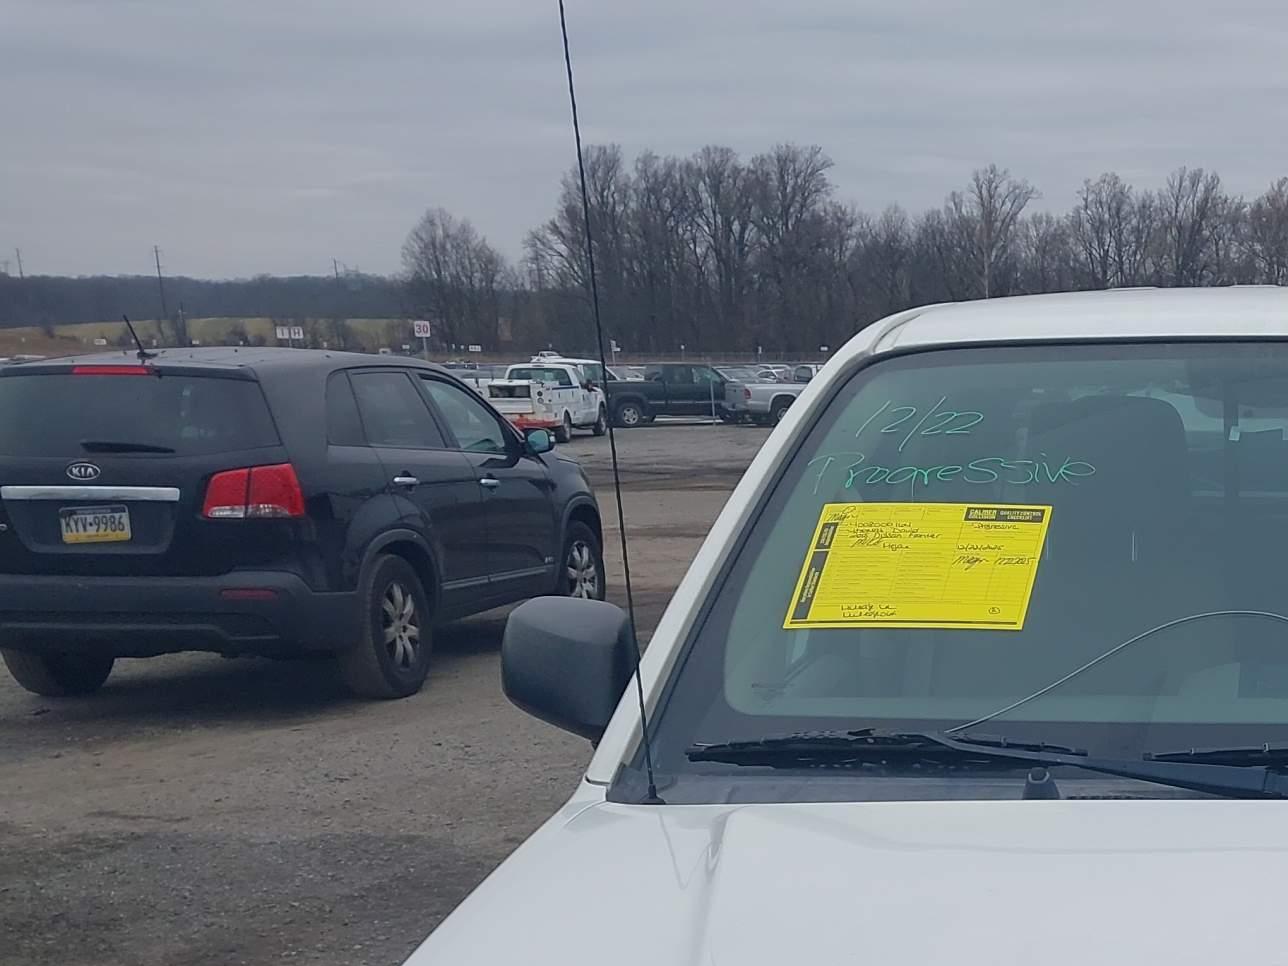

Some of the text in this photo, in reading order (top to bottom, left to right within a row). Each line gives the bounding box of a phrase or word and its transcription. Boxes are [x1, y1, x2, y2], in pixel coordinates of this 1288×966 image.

[415, 324, 429, 335] 30
[856, 396, 984, 451] 12/22
[72, 467, 94, 477] KIA
